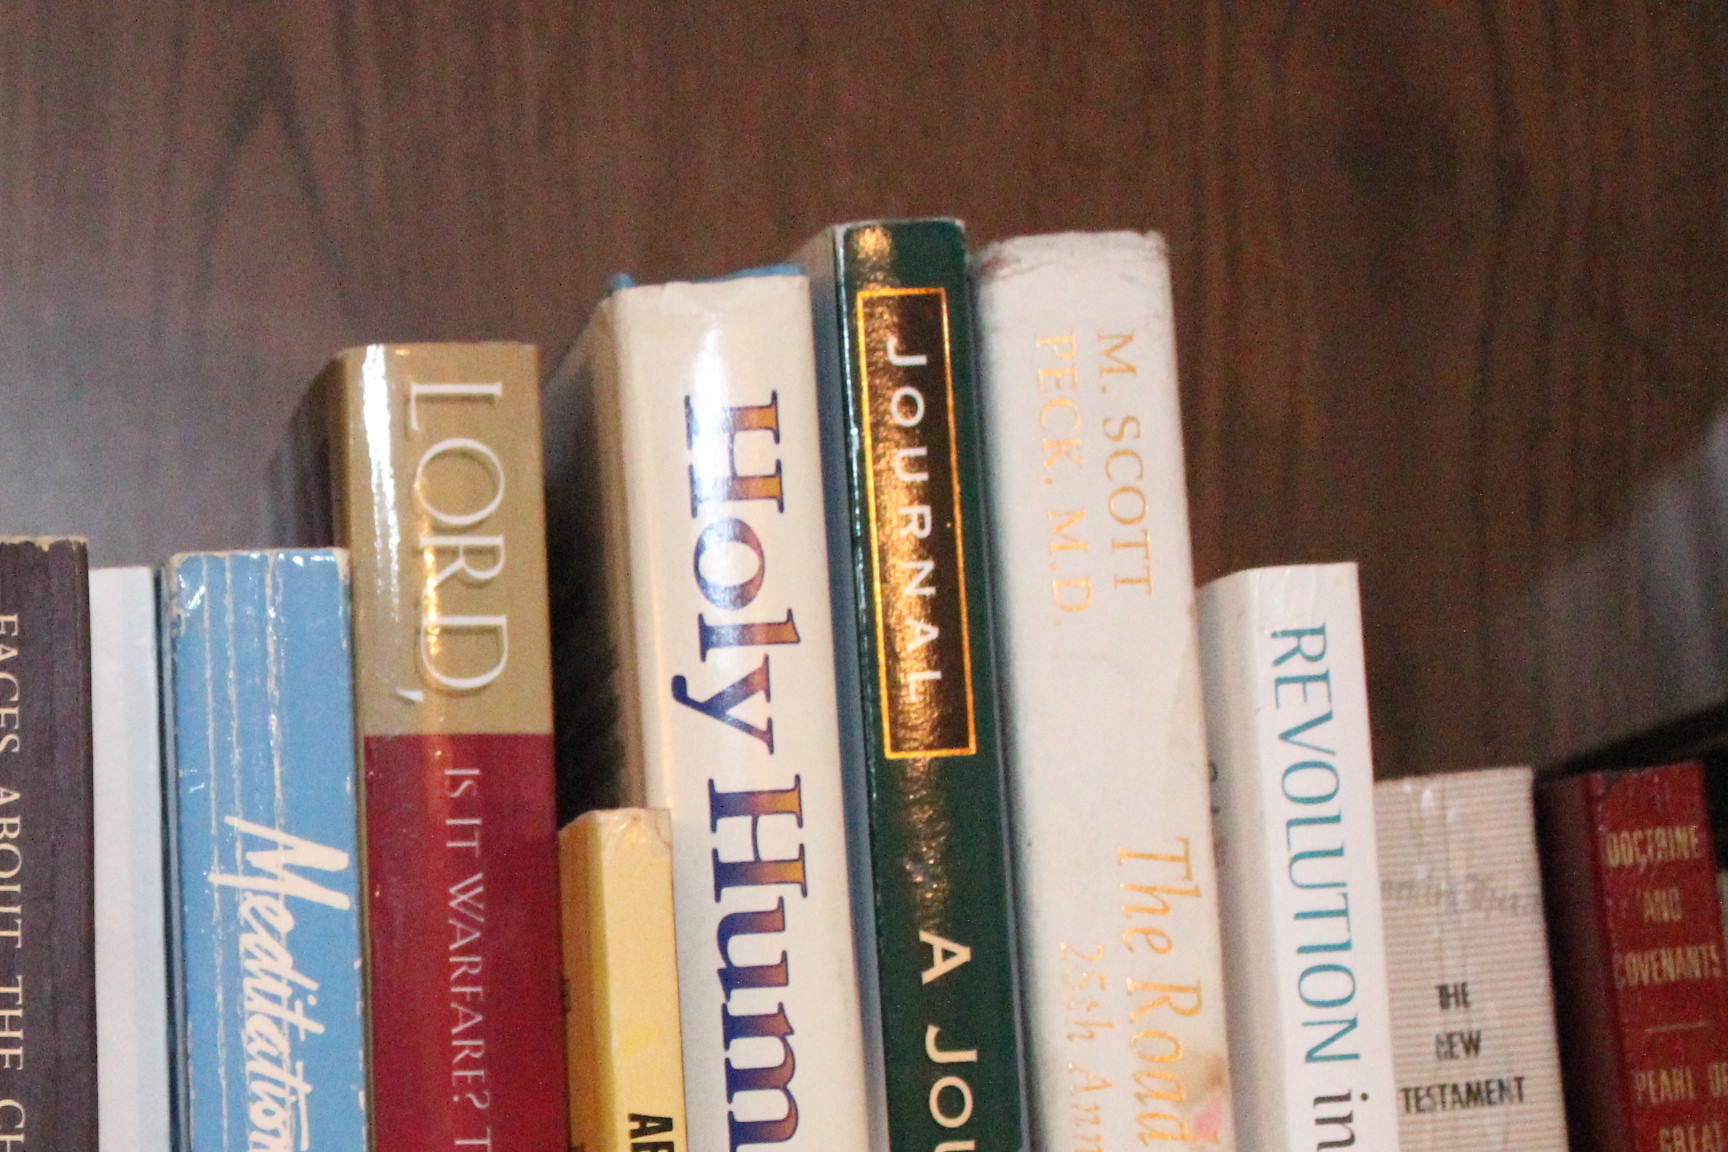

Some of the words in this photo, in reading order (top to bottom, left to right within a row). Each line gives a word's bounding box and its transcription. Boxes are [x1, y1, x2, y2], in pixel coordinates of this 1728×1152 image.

[1097, 331, 1137, 393] M.
[396, 381, 509, 703] LORD,
[887, 338, 942, 702] JOURNAL
[1103, 415, 1152, 595] SCOTT
[672, 390, 801, 755] Holy
[1048, 508, 1093, 626] M.D.
[444, 769, 481, 798] IS
[445, 819, 482, 857] IT
[1116, 838, 1201, 954] The
[1270, 623, 1360, 1064] REVOLUTION
[1606, 826, 1698, 868] DOCTRINE
[447, 872, 490, 1109] WARFARE?
[920, 930, 972, 985] A
[1060, 943, 1113, 1042] 25th
[1127, 977, 1218, 1146] Road
[1400, 1076, 1525, 1113] TESTAMENT
[1312, 1088, 1370, 1152] in
